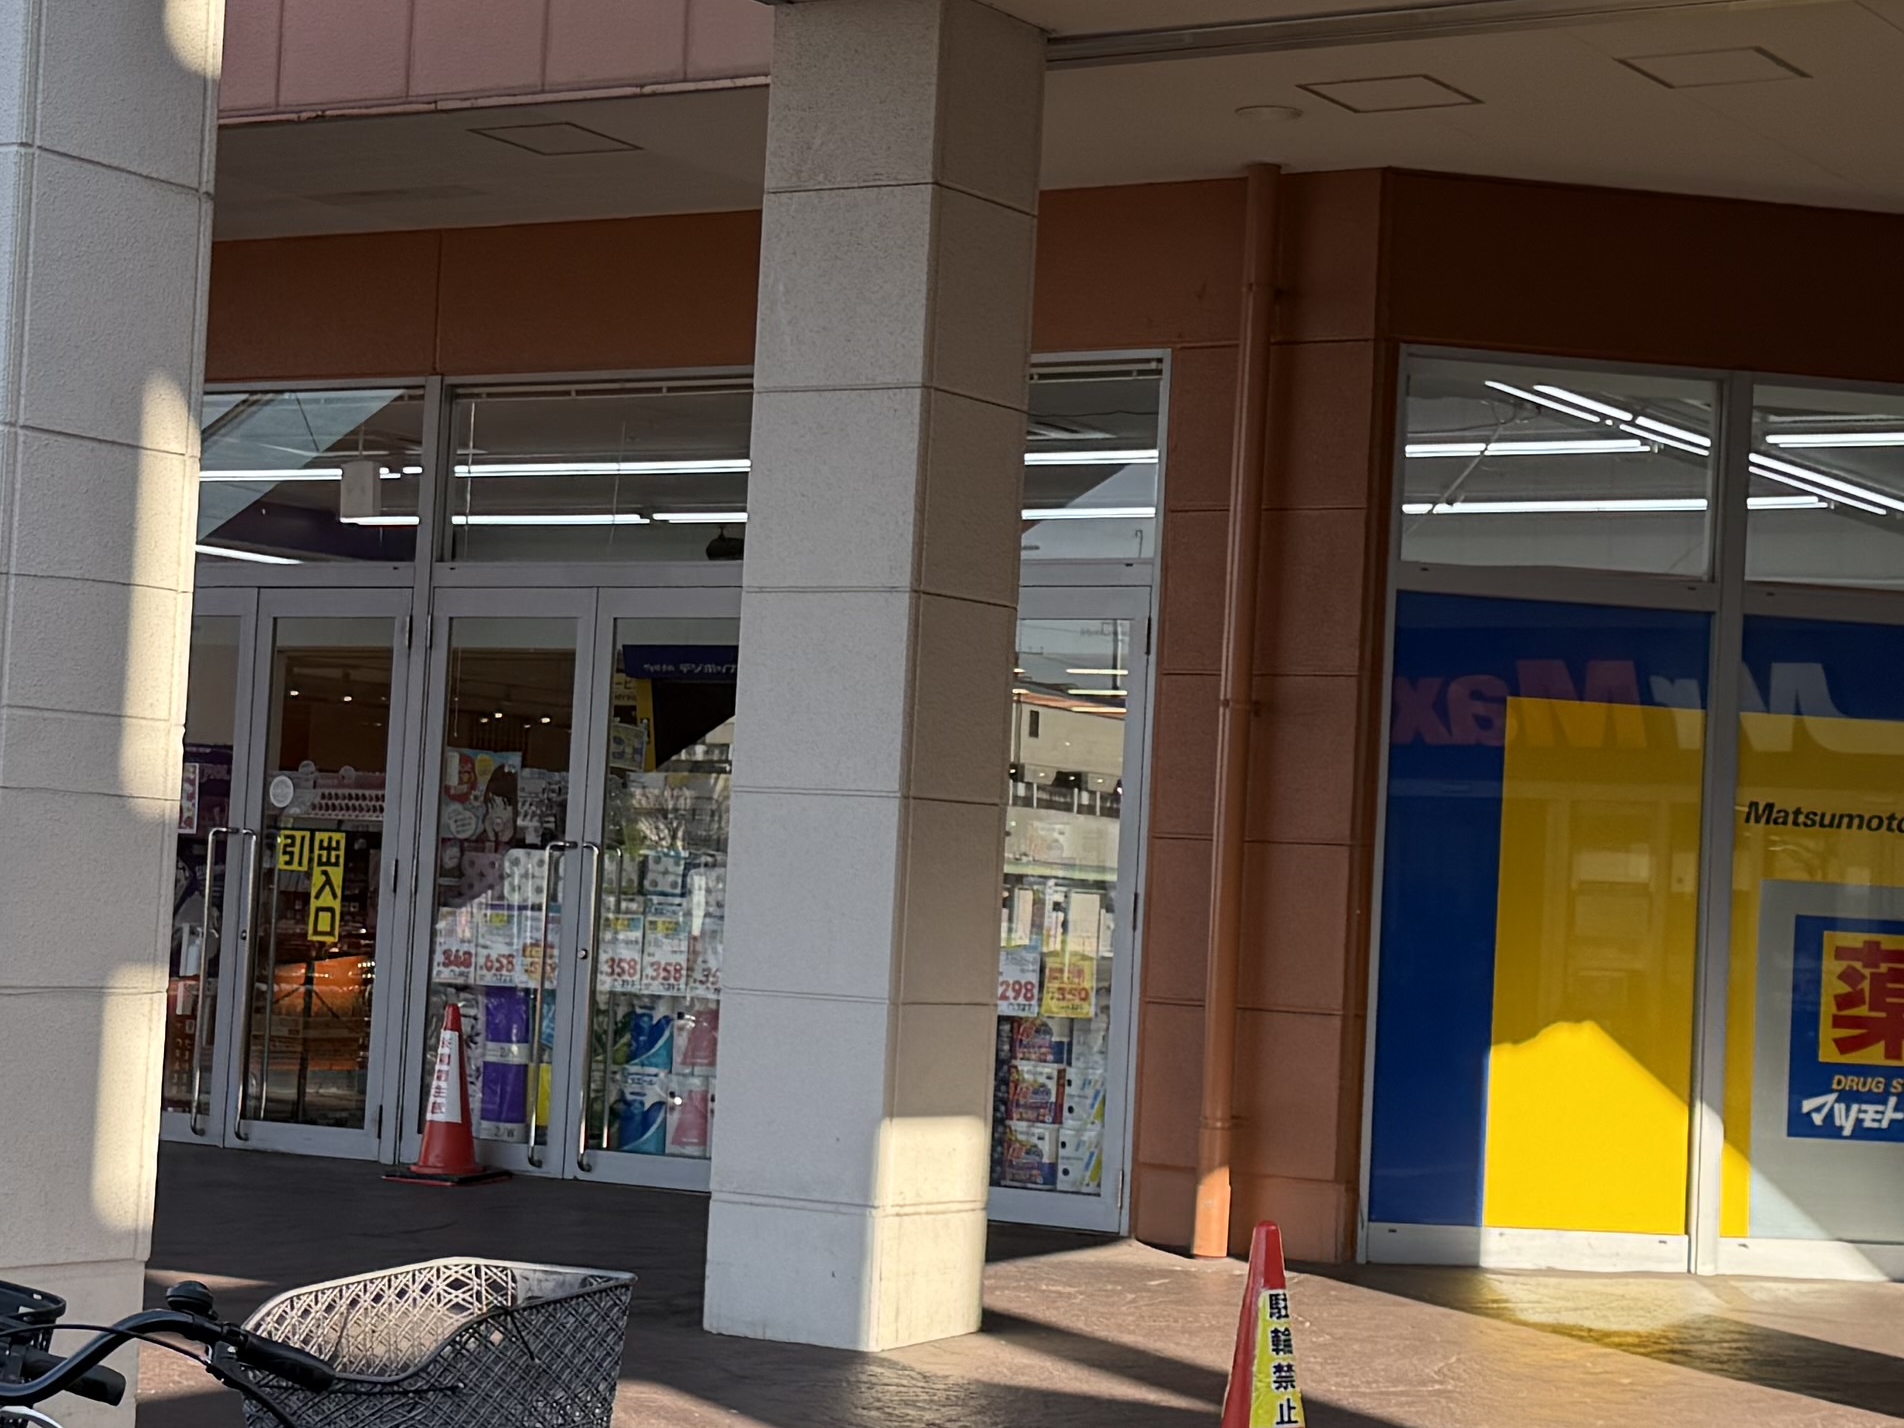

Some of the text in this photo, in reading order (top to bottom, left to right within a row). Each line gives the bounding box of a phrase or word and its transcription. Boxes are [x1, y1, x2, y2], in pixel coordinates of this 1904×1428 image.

[282, 834, 306, 868] 引
[312, 835, 341, 937] 出入口
[998, 980, 1036, 1002] 298
[1832, 1074, 1885, 1096] DRUG
[1268, 1292, 1299, 1426] 駐輪禁止
